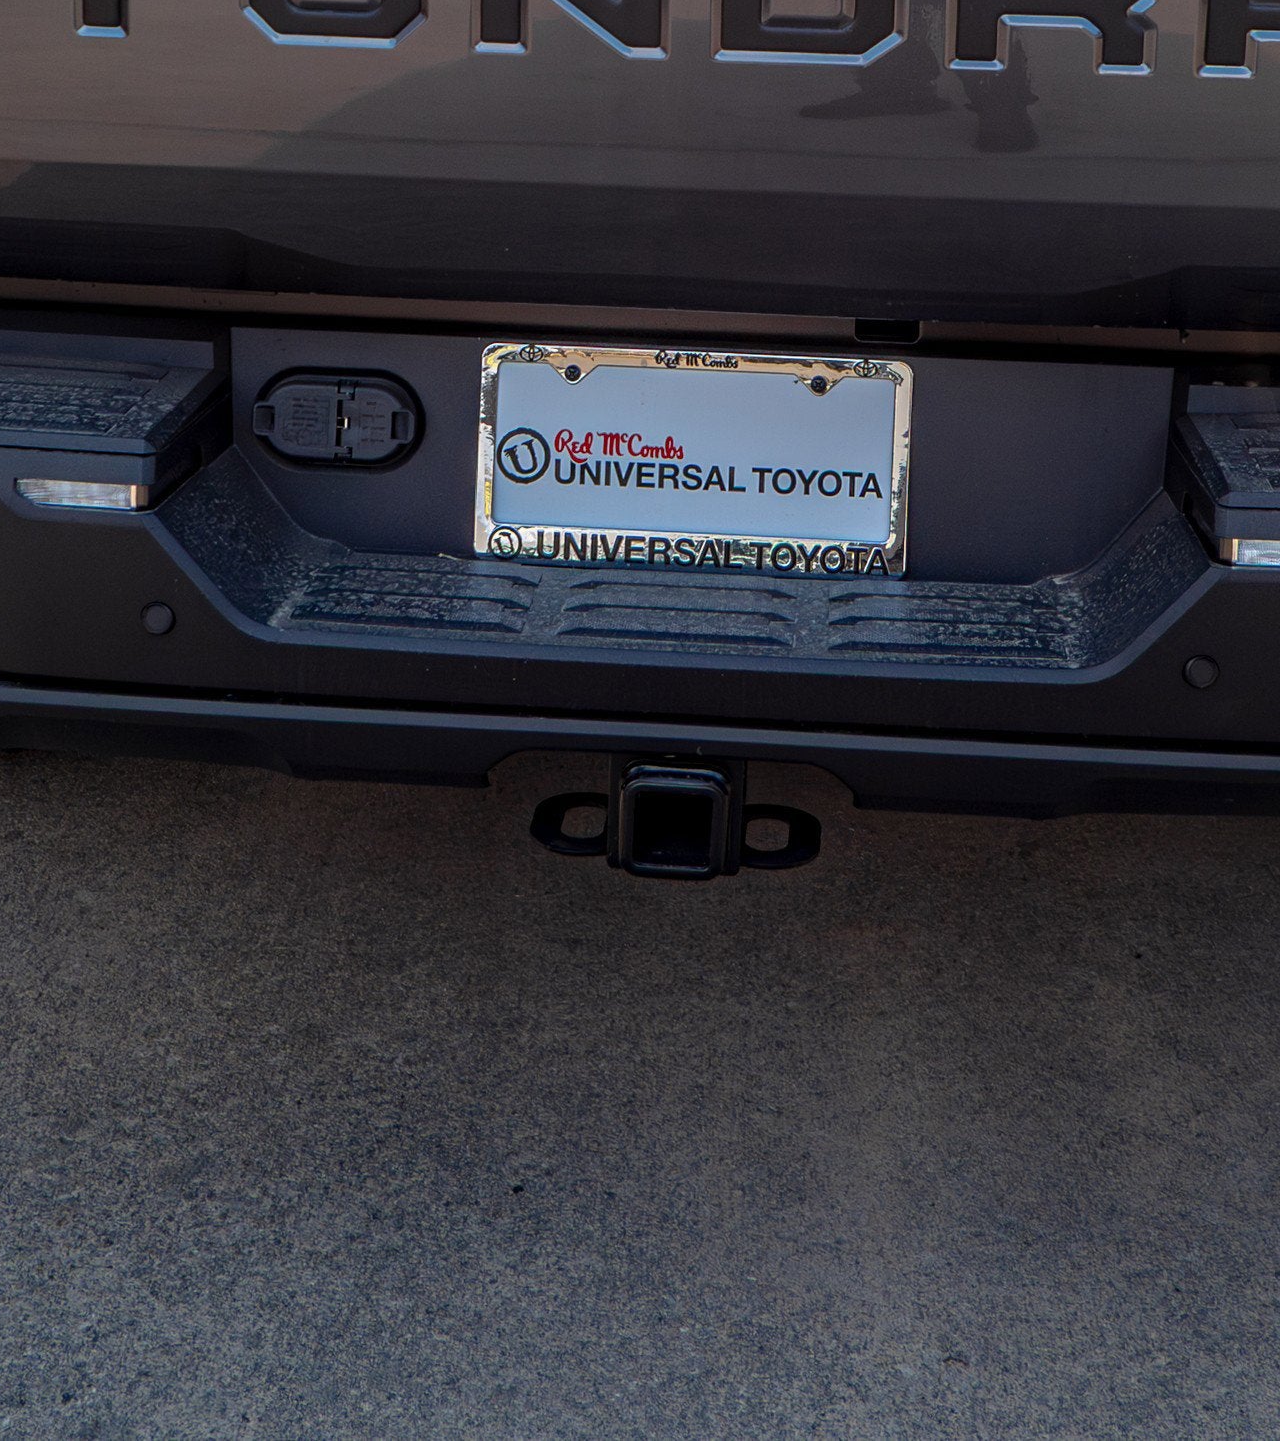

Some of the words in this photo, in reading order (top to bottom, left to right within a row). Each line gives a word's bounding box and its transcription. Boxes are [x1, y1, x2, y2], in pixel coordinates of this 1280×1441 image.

[654, 349, 682, 368] Red
[682, 352, 738, 369] McCombs
[554, 428, 594, 464] Red
[597, 431, 684, 460] McCombs
[553, 458, 747, 494] UNIVERSAL
[752, 466, 884, 500] TOYOTA
[537, 530, 744, 569] UNIVERSAL
[748, 540, 890, 577] TOYOTA
